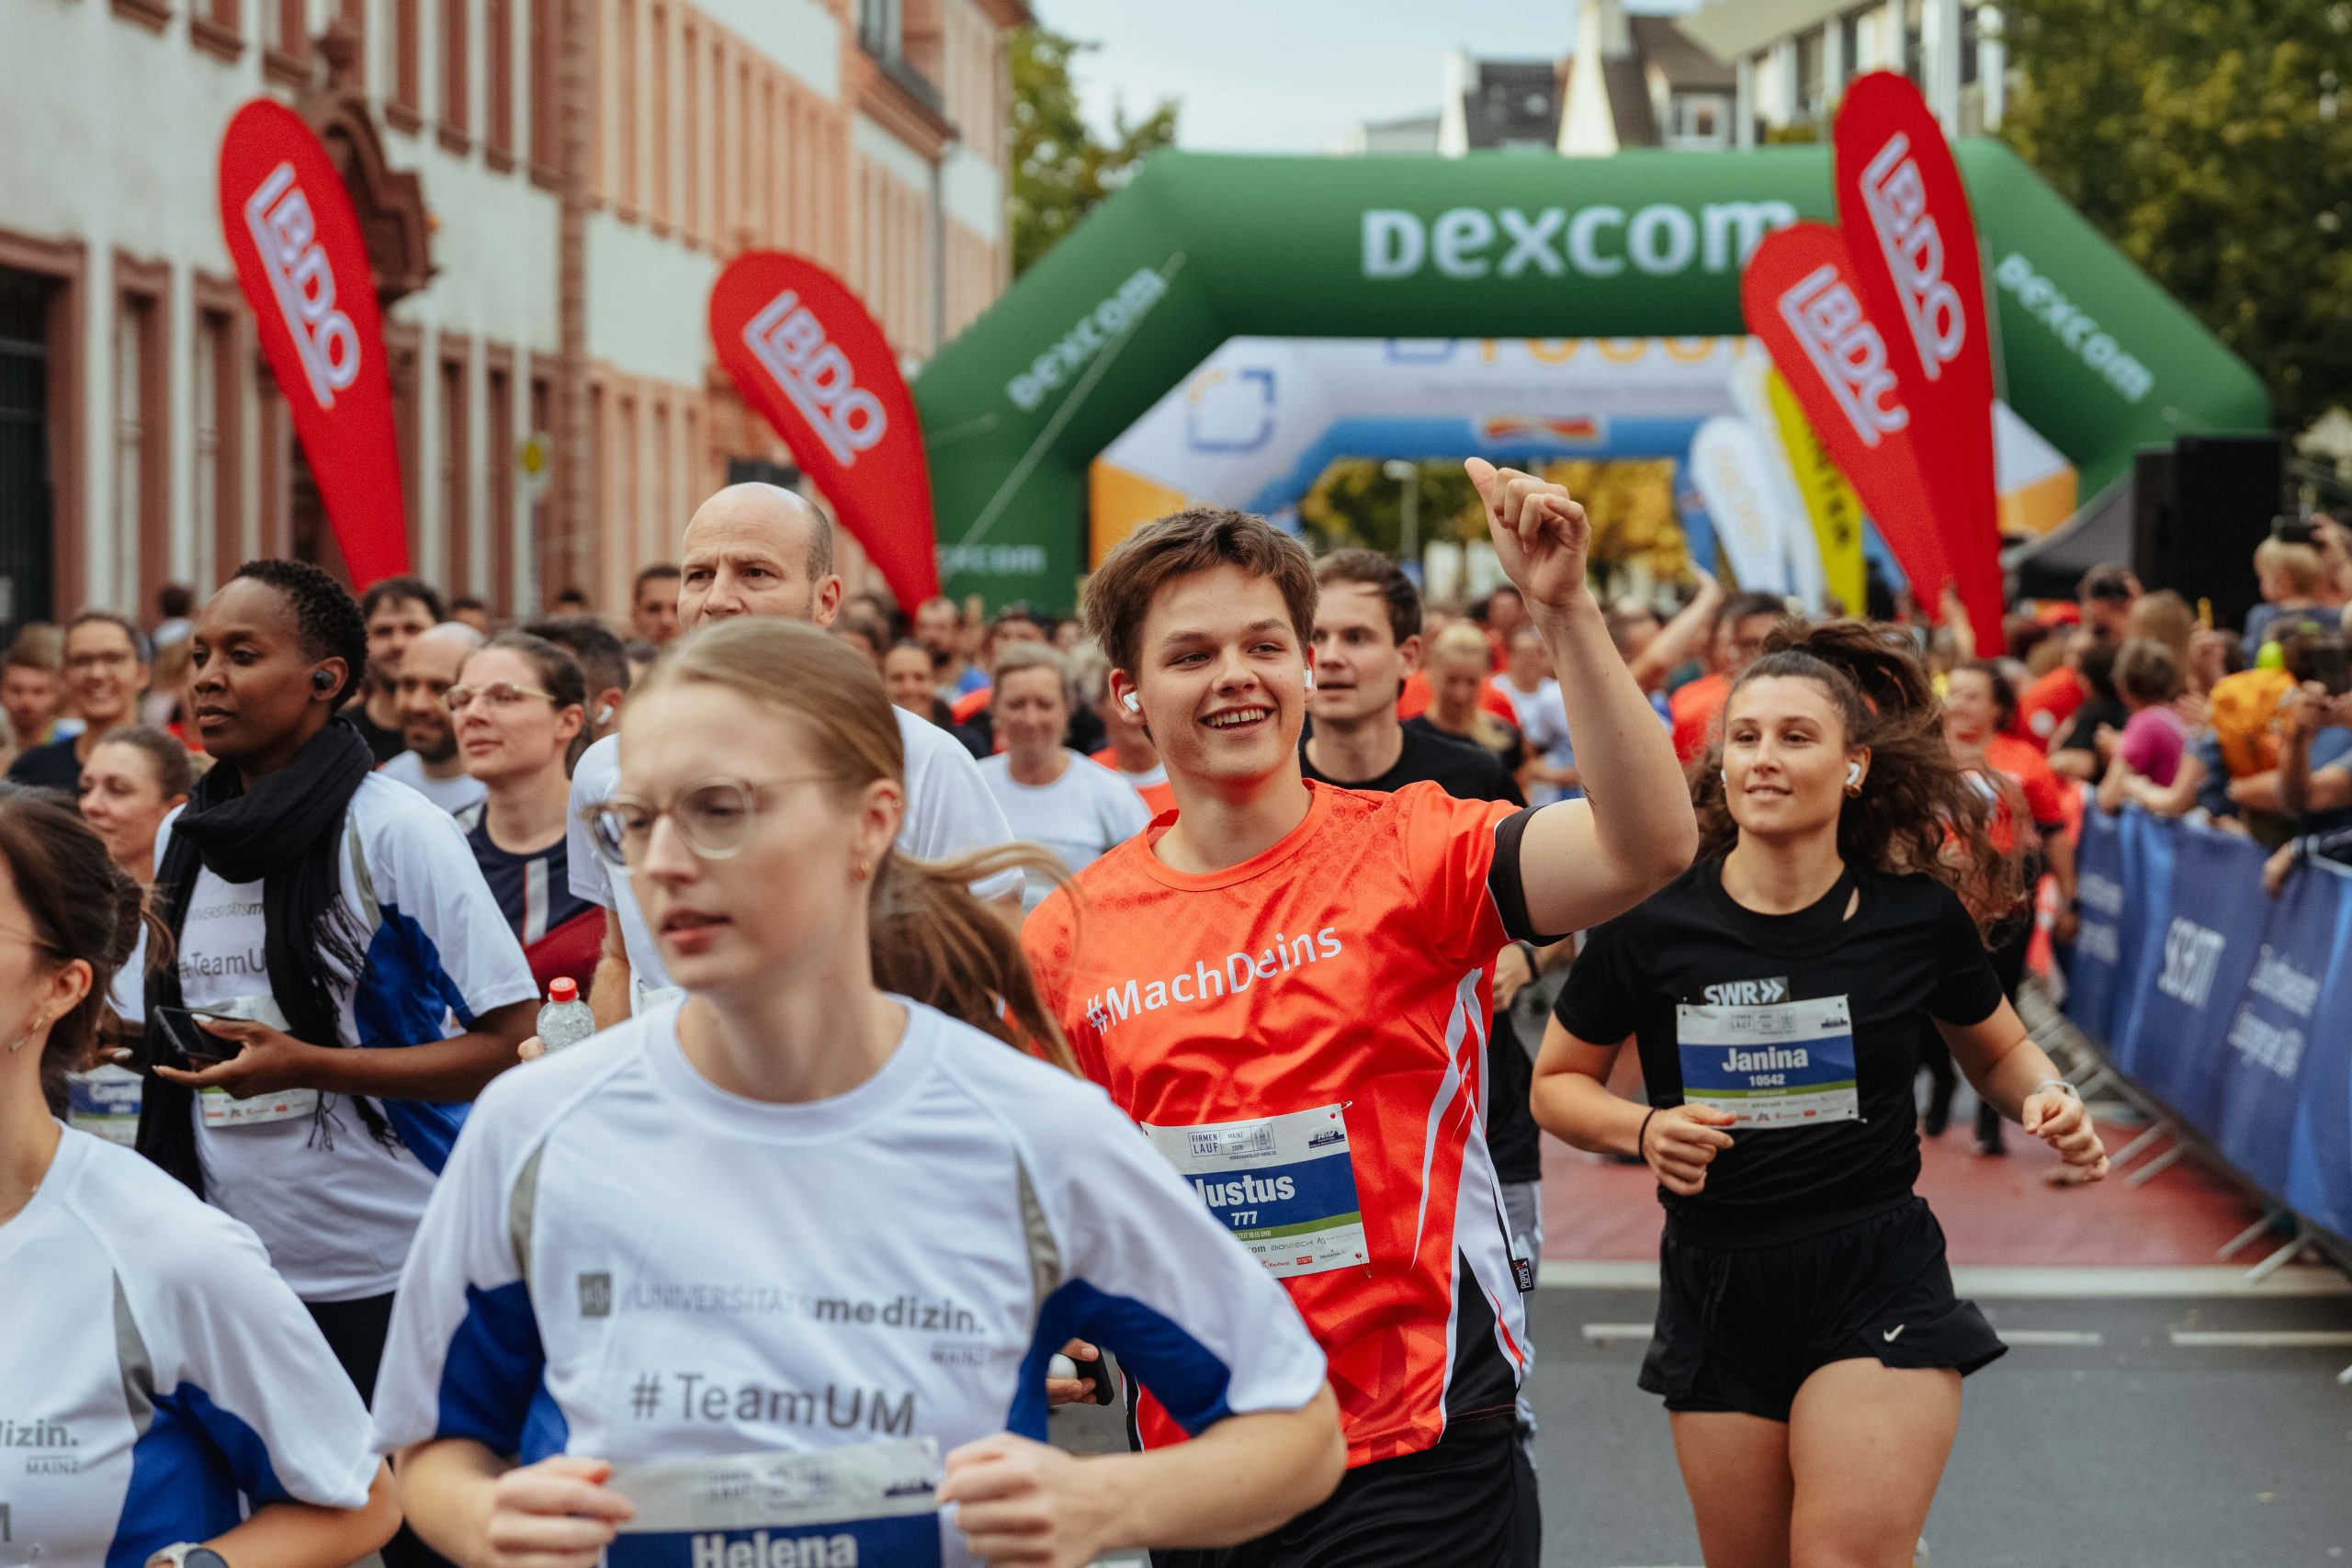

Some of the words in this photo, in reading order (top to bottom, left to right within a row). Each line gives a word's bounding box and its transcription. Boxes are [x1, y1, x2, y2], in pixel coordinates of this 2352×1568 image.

[1884, 158, 1965, 362] BDO
[270, 187, 361, 389] BDO
[771, 306, 888, 450] BDO
[1086, 926, 1342, 1035] #MachDeins
[1722, 1046, 1809, 1073] Janina
[1748, 1073, 1786, 1088] 10542
[1192, 1133, 1217, 1143] FIRMEN
[1193, 1142, 1219, 1155] LAUF
[1231, 1210, 1258, 1226] 777
[26, 1460, 81, 1476] MAINZ
[691, 1529, 859, 1568] Helena
